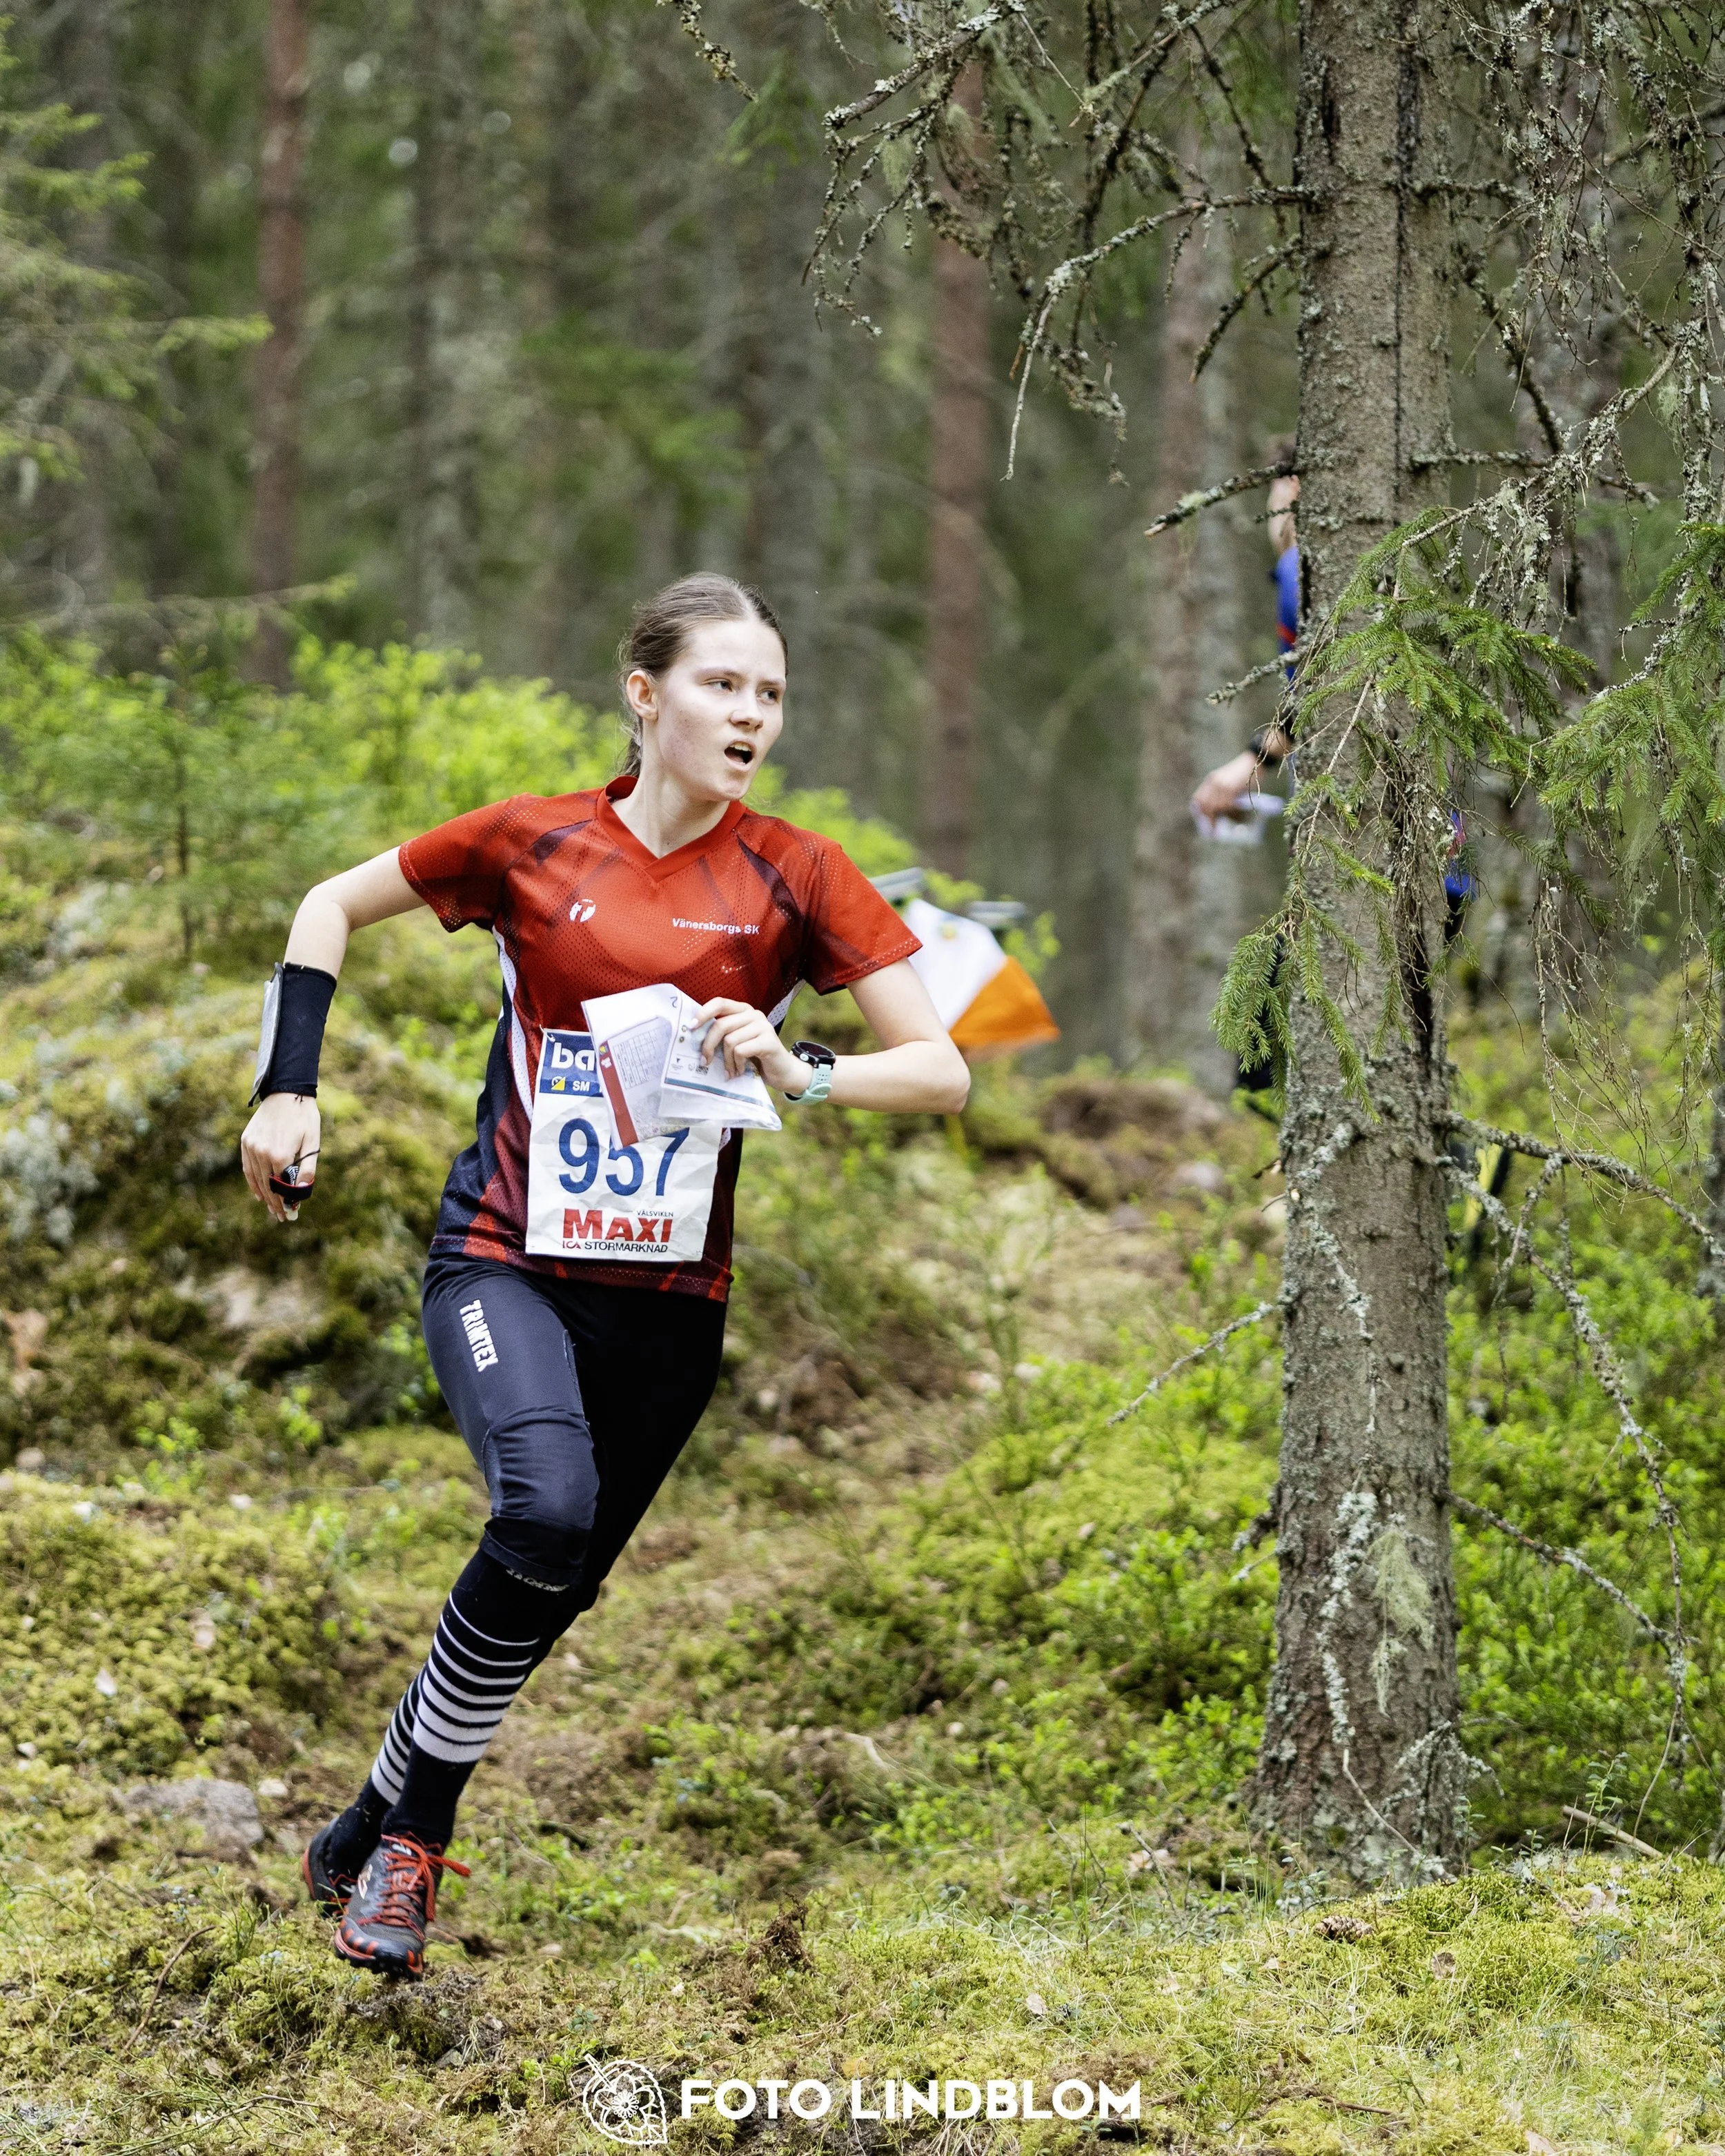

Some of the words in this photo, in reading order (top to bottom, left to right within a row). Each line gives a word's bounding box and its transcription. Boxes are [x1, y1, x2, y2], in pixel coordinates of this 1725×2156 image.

[672, 918, 742, 935] Vänersborgs
[743, 924, 760, 935] SK
[572, 1080, 591, 1091] SM
[559, 1118, 690, 1196] 957
[637, 1209, 674, 1217] VÄLSVIKEN
[563, 1208, 673, 1243] MAXI
[562, 1240, 582, 1249] ICA
[584, 1241, 669, 1253] STORMARKNAD
[460, 1299, 499, 1372] TRIMTEX
